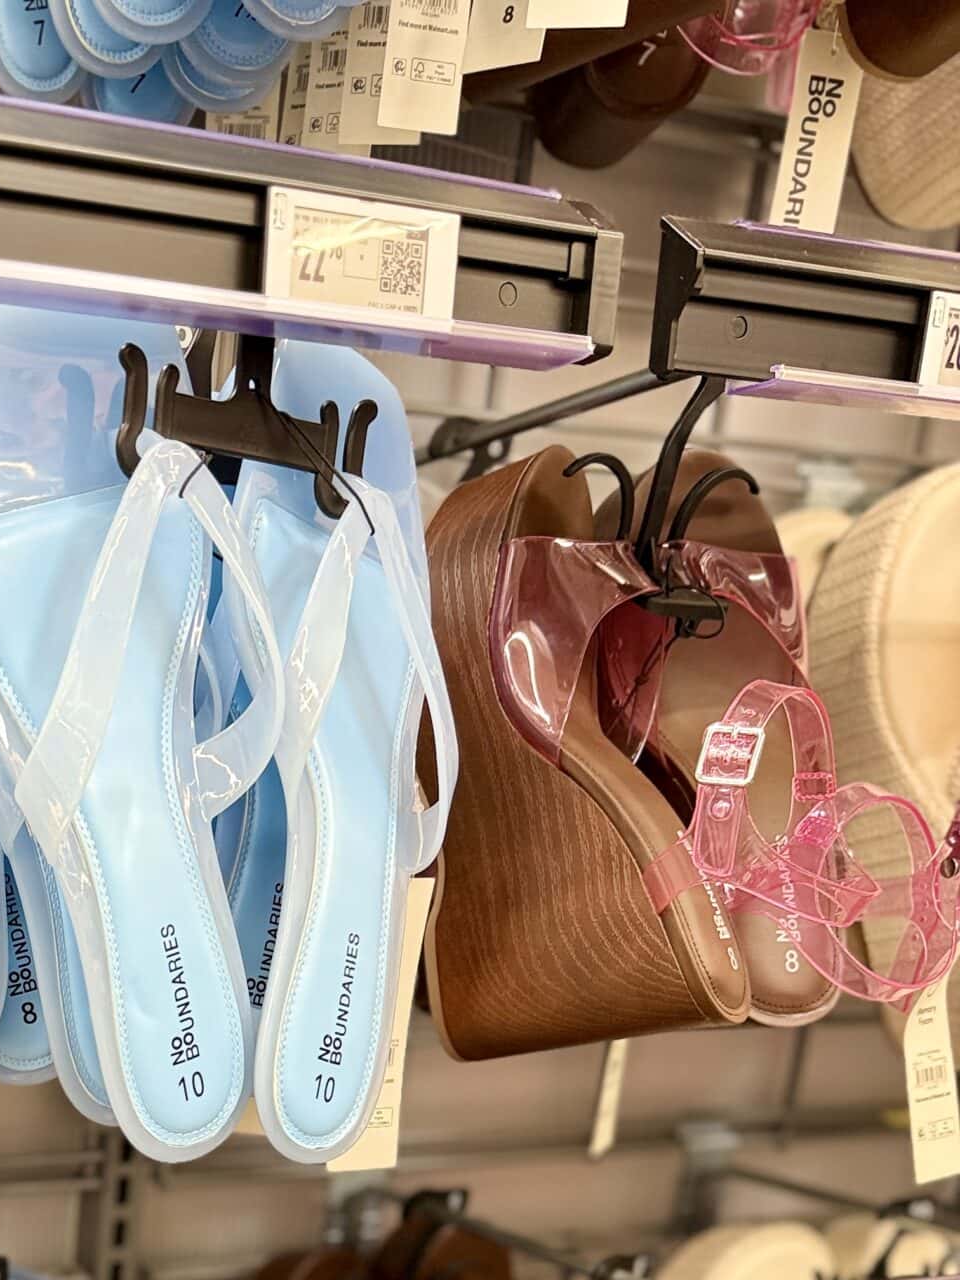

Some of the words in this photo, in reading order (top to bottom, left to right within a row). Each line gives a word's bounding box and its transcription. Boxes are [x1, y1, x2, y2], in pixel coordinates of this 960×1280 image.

[503, 6, 514, 23] 8
[33, 20, 44, 45] 7
[638, 41, 656, 65] 7
[823, 77, 844, 118] NO
[785, 949, 800, 972] 8
[8, 971, 23, 996] NO
[160, 923, 200, 1062] BOUNDARIES
[21, 1002, 38, 1024] 8
[328, 932, 361, 1066] BOUNDARIES
[170, 1036, 186, 1066] NO
[317, 1034, 333, 1063] NO
[178, 1070, 206, 1102] 10
[313, 1073, 337, 1104] 10
